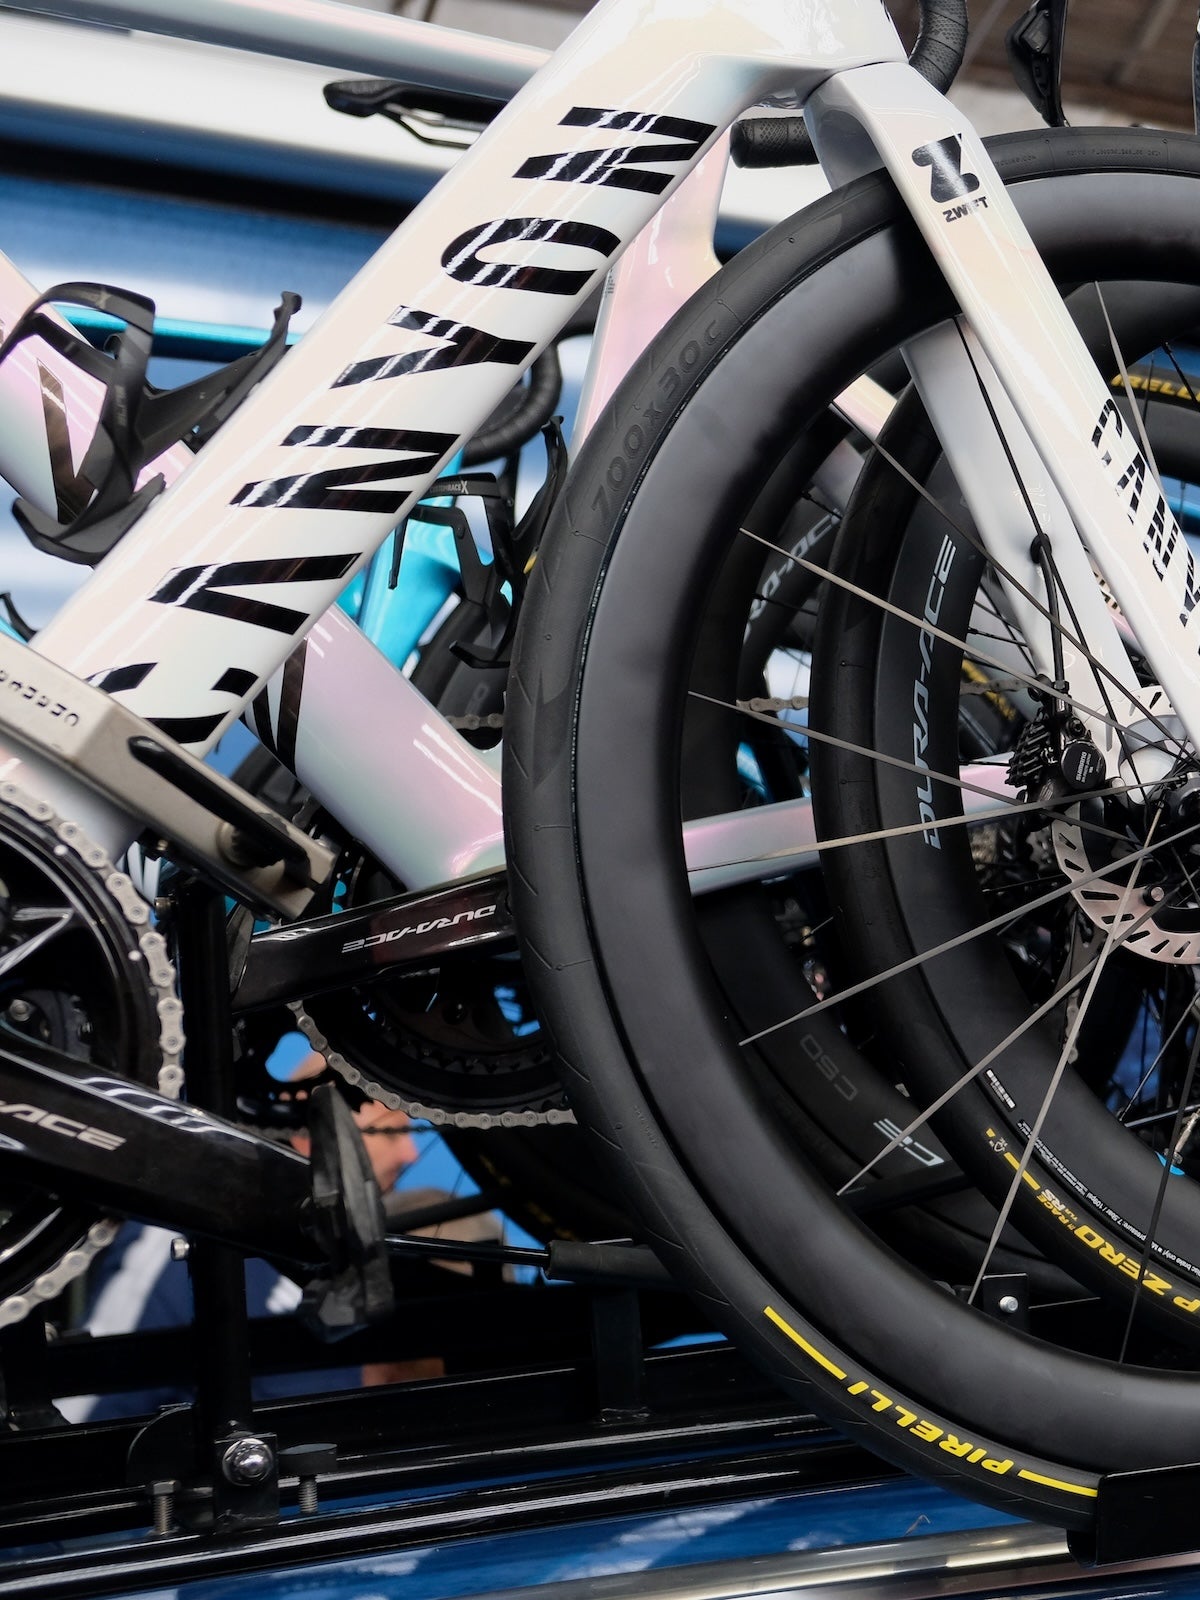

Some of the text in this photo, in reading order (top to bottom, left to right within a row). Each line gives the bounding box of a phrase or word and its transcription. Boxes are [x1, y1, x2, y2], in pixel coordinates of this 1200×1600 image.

[942, 196, 989, 223] ZWIFT
[88, 106, 717, 744] CANYON
[914, 534, 956, 850] DURA-ACE
[342, 904, 496, 954] DURA-ACE
[1036, 1194, 1069, 1225] RACE
[1041, 1188, 1066, 1211] RS
[1074, 1225, 1172, 1295] ZERO
[848, 1380, 1015, 1476] PIRELLI
